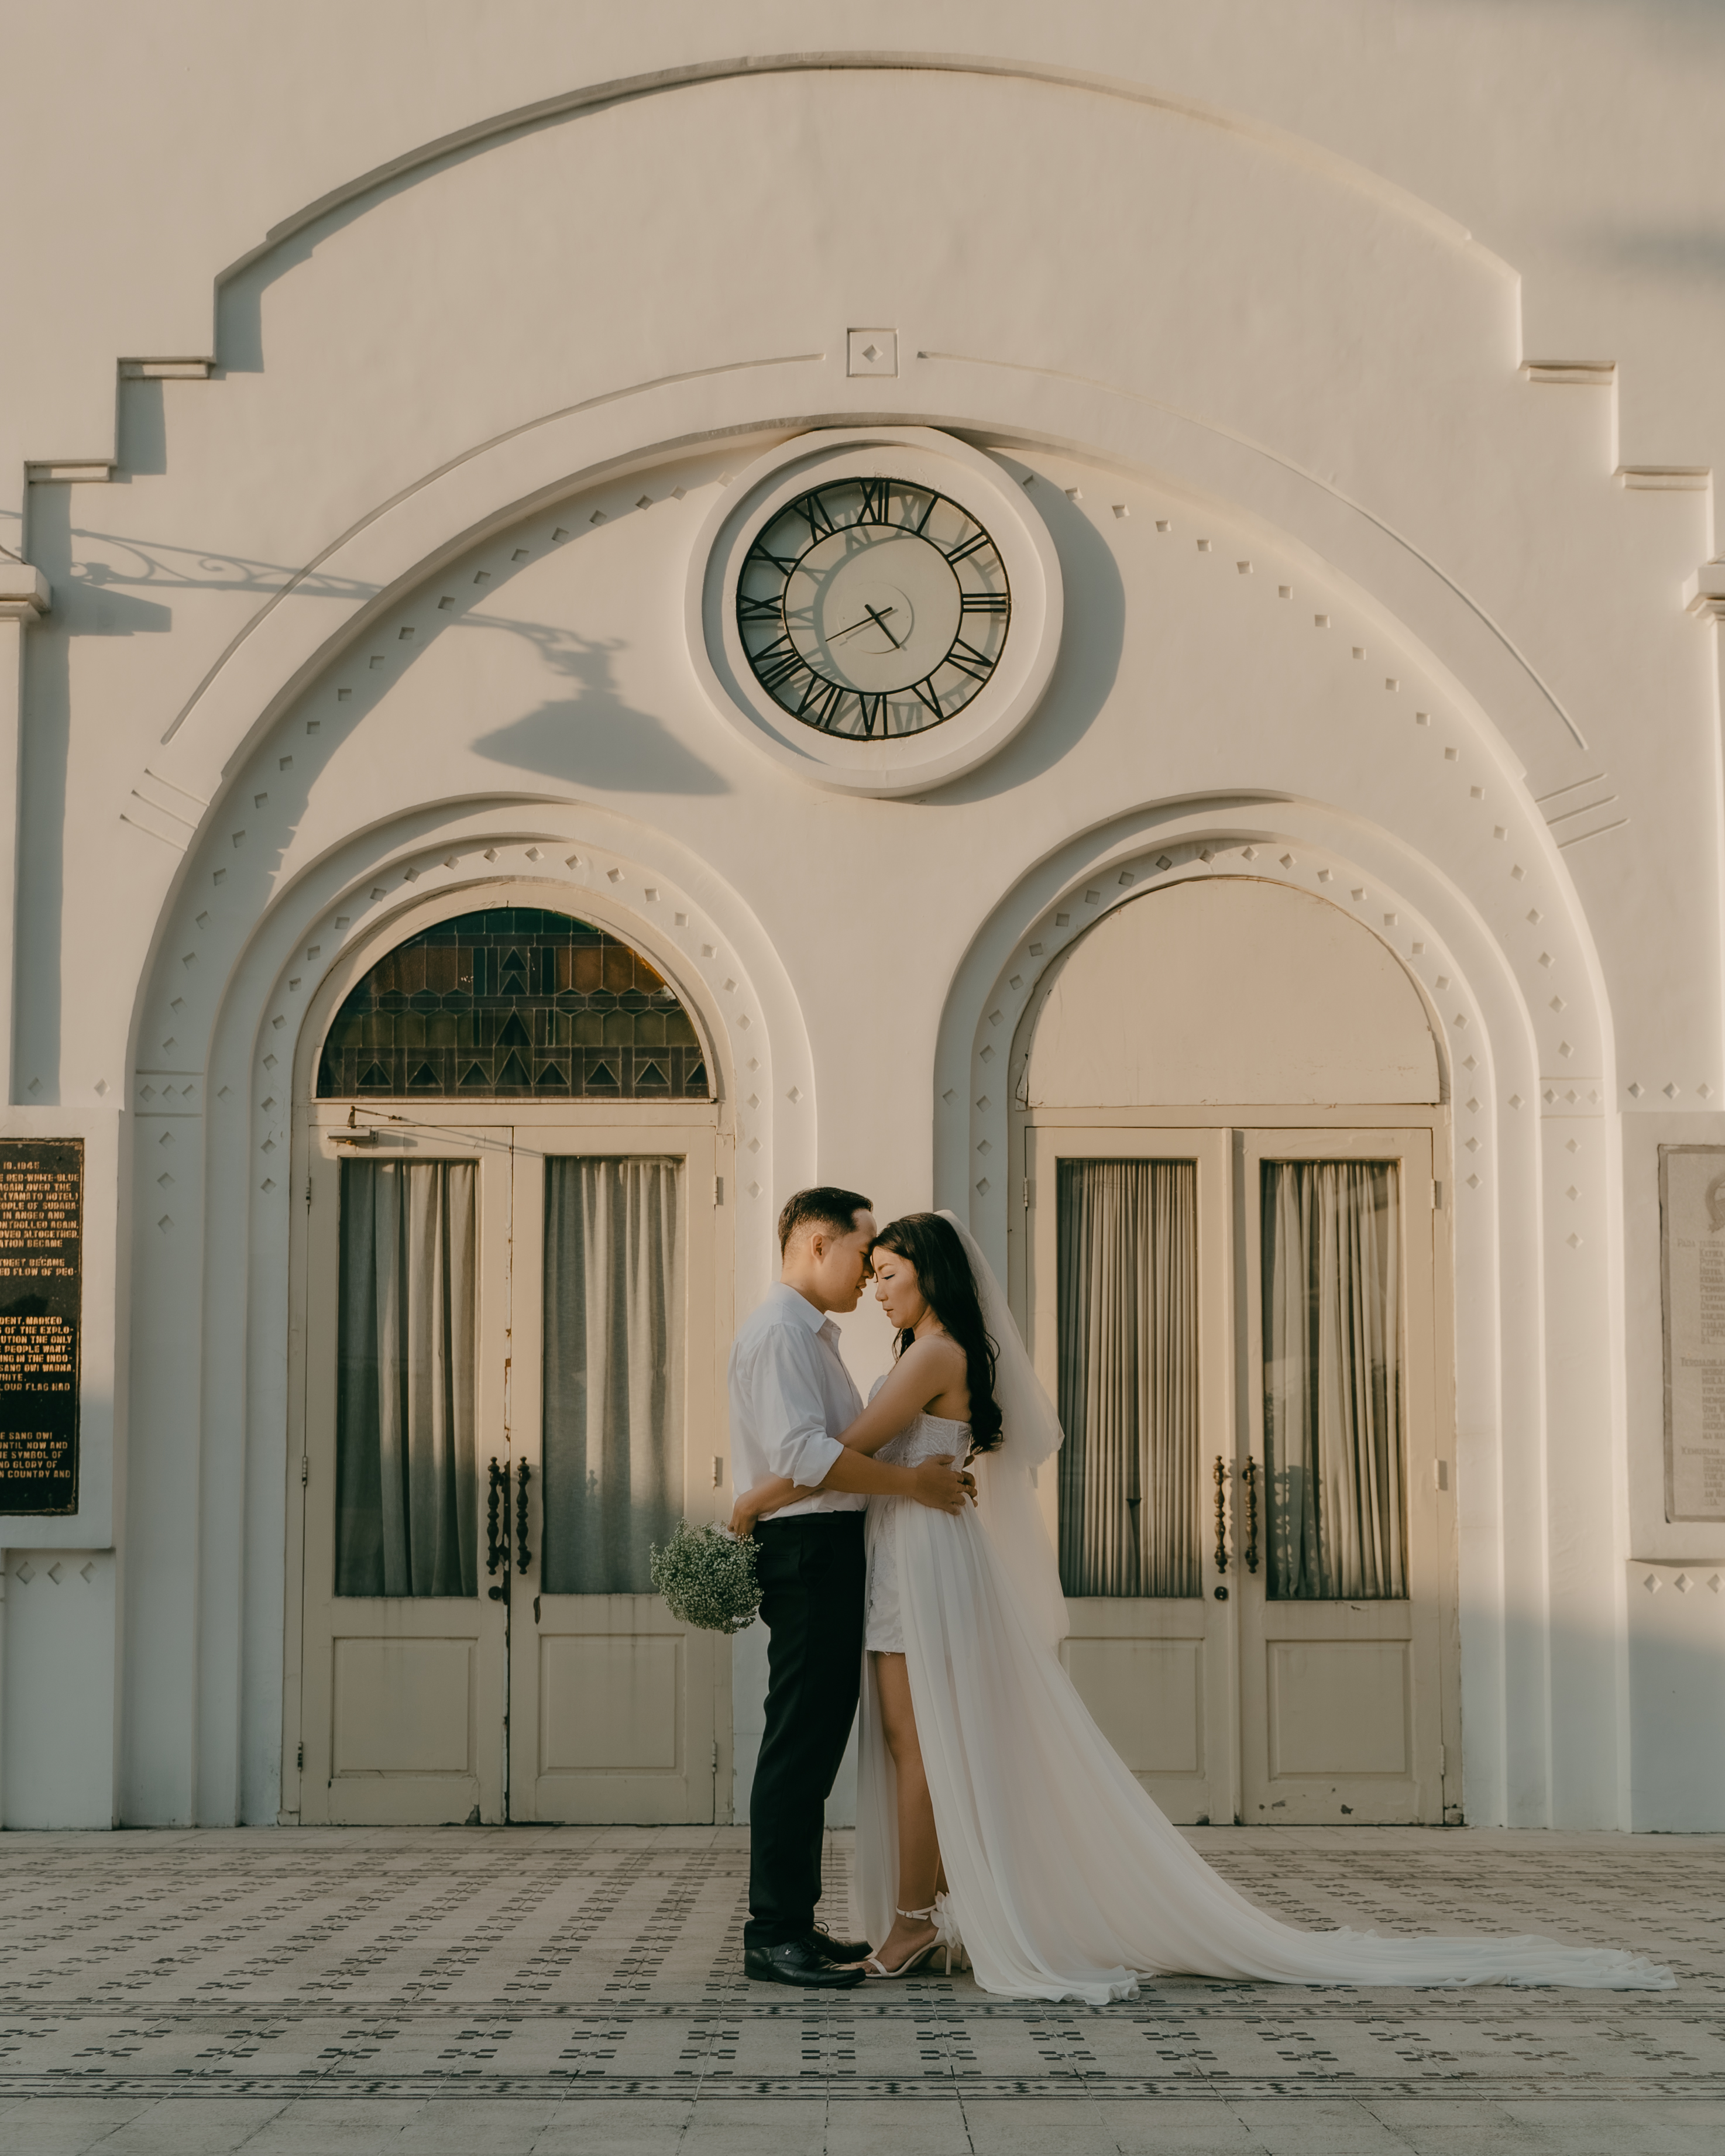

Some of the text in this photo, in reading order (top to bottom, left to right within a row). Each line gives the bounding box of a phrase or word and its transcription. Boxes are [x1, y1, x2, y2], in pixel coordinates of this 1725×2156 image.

[857, 480, 891, 523] XII
[917, 496, 938, 534] I
[793, 494, 835, 542] XI
[750, 546, 799, 575] X
[946, 532, 991, 565] II
[740, 594, 784, 620] IX
[963, 594, 1008, 613] III
[753, 635, 806, 690] VIII
[945, 639, 994, 683] IV
[798, 675, 843, 728] VII
[912, 678, 944, 719] V
[860, 694, 888, 735] VI
[26, 1183, 50, 1191] OVER
[54, 1183, 71, 1191] THE
[0, 1202, 24, 1210] OPLE
[28, 1202, 39, 1210] OF
[28, 1240, 63, 1248] BECAME
[13, 1268, 38, 1276] FLOW
[42, 1268, 53, 1276] OF
[29, 1258, 65, 1267] BECAME
[5, 1345, 40, 1353] PEOPLE
[16, 1354, 25, 1363] IN
[28, 1354, 44, 1363] THE
